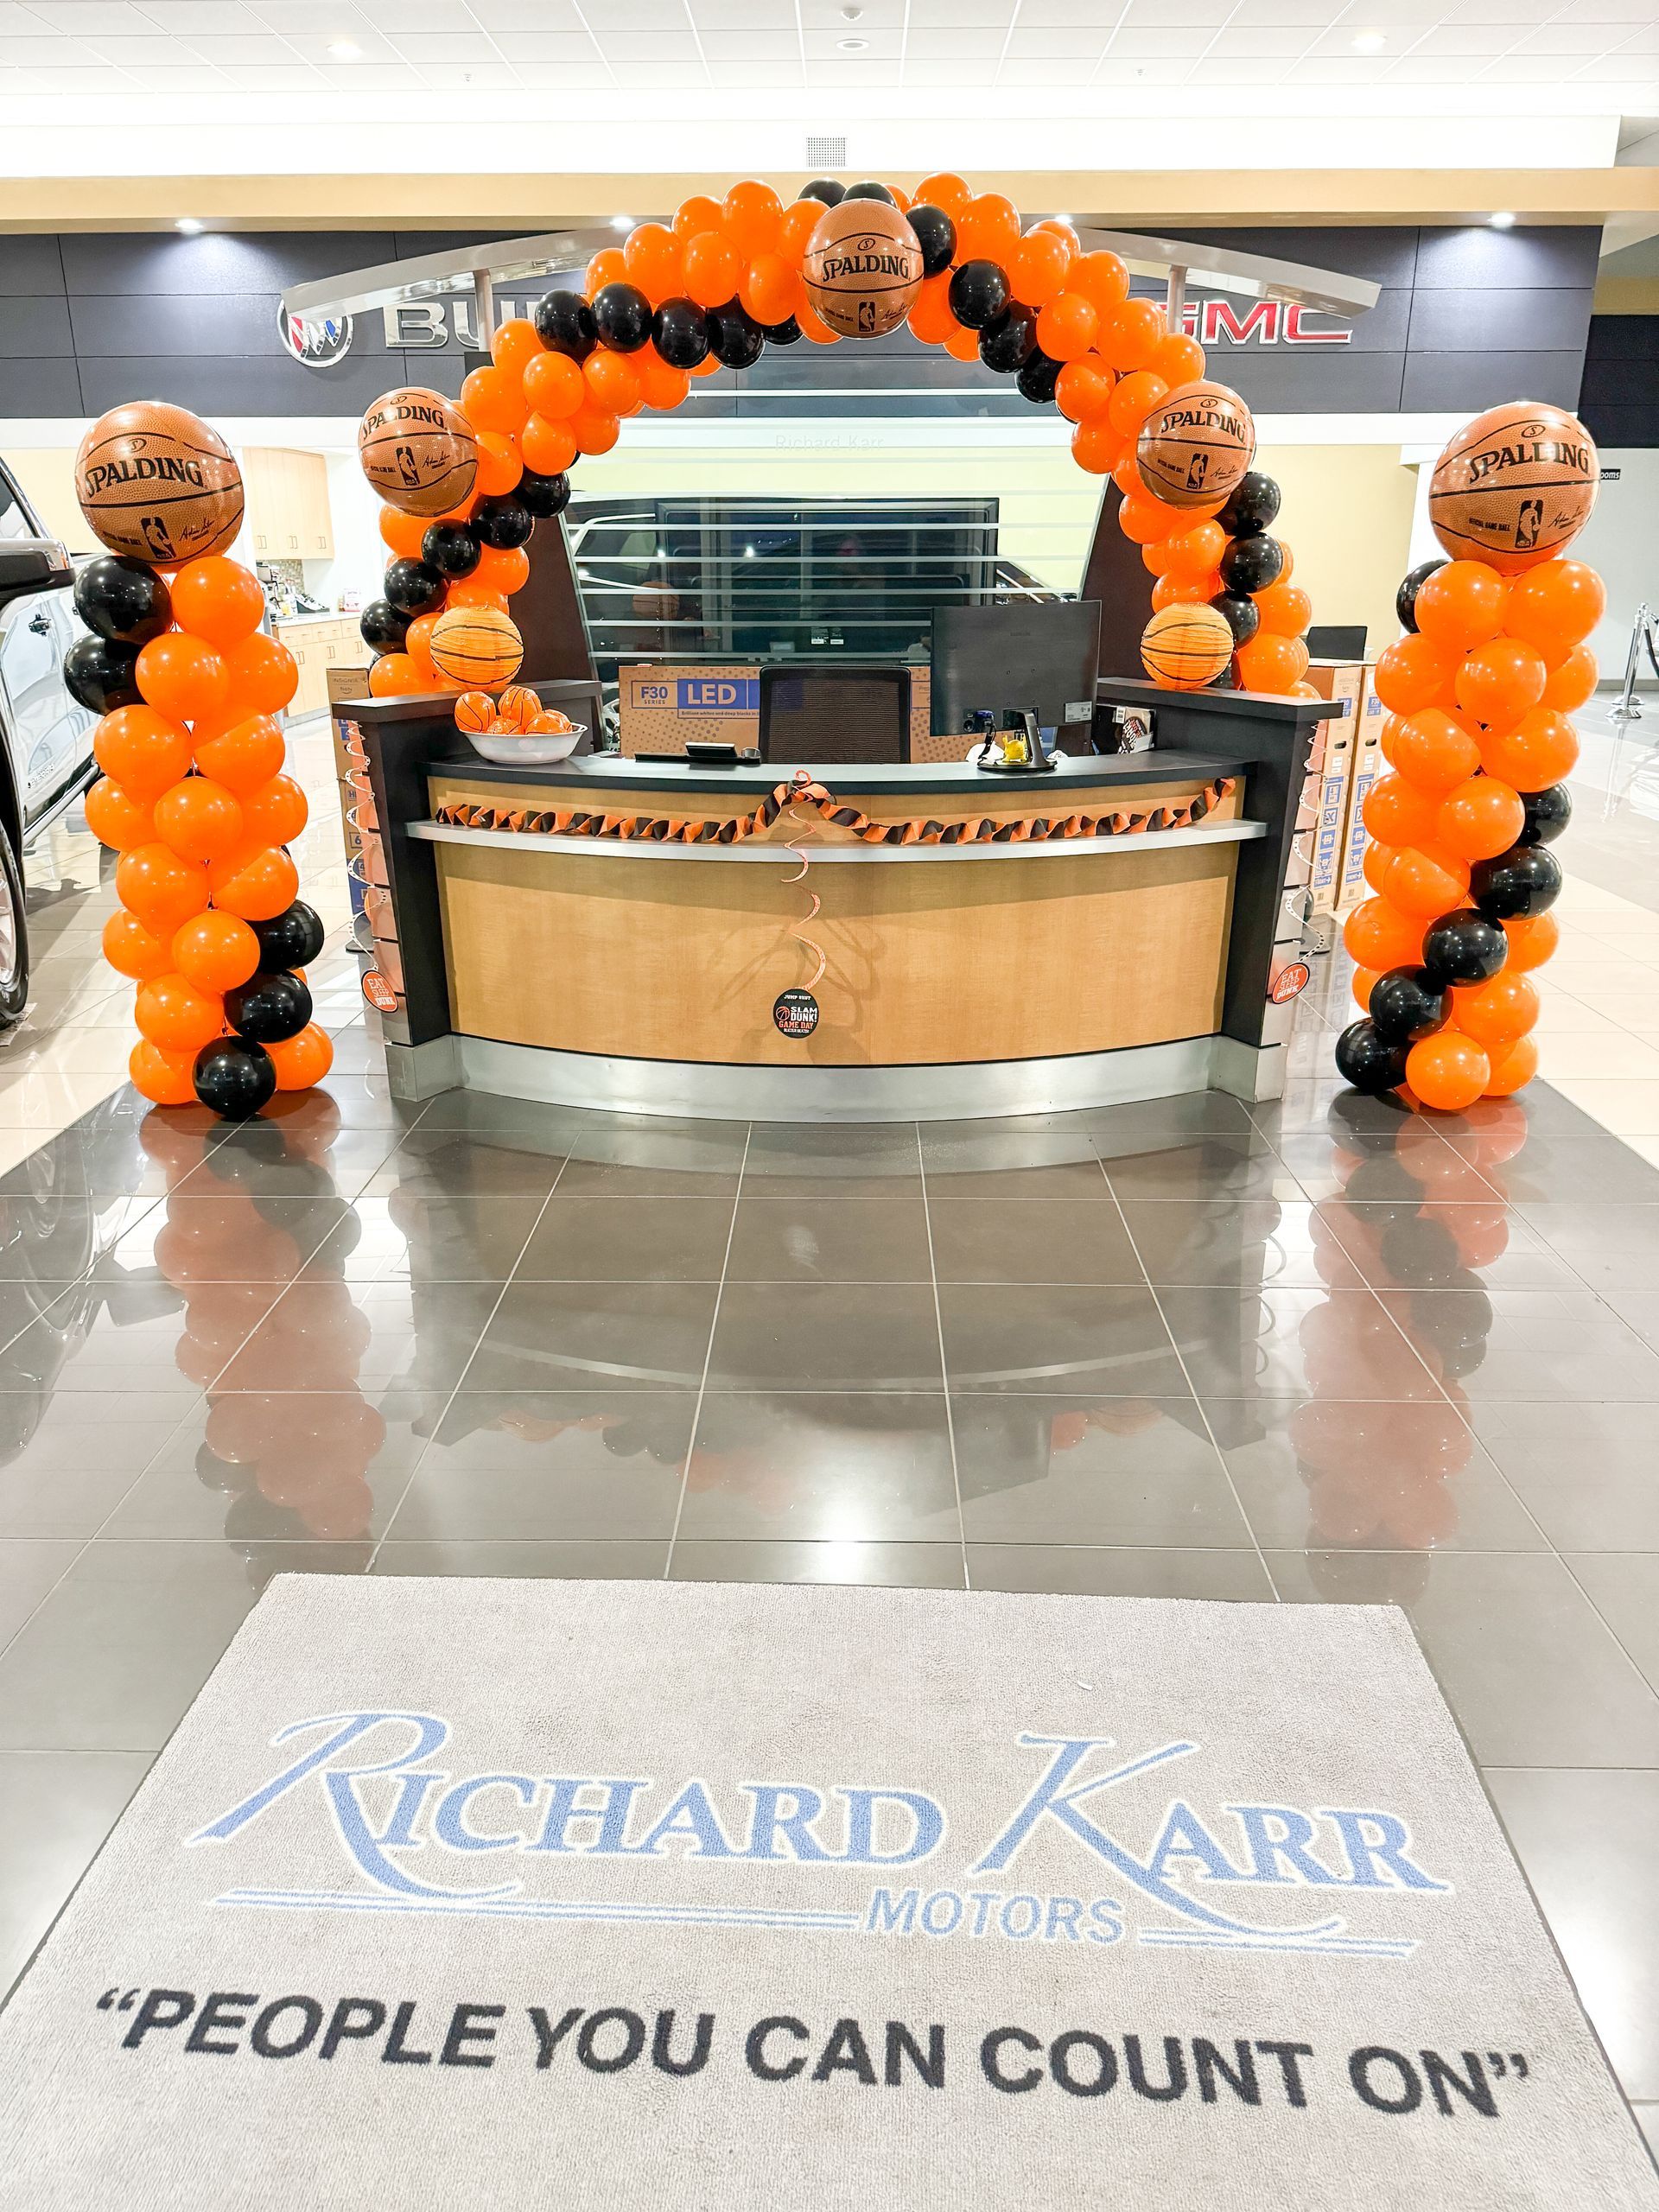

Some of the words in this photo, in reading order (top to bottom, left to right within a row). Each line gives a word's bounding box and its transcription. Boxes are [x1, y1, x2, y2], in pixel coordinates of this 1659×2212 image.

[823, 254, 908, 282] SPALDING
[363, 406, 445, 440] SPADING
[1160, 410, 1246, 443] SPALDING
[85, 457, 204, 498] SPALDING
[641, 686, 668, 699] F30
[687, 683, 737, 705] LED
[366, 978, 385, 989] EAT
[1282, 969, 1301, 984] EAT
[790, 1013, 817, 1022] DUNK!
[184, 1711, 948, 1901] RICHARD
[865, 1888, 1127, 1944] MOTORS
[526, 2005, 716, 2075] YOU
[745, 2014, 946, 2088] CAN
[979, 2025, 1313, 2108] COUNT
